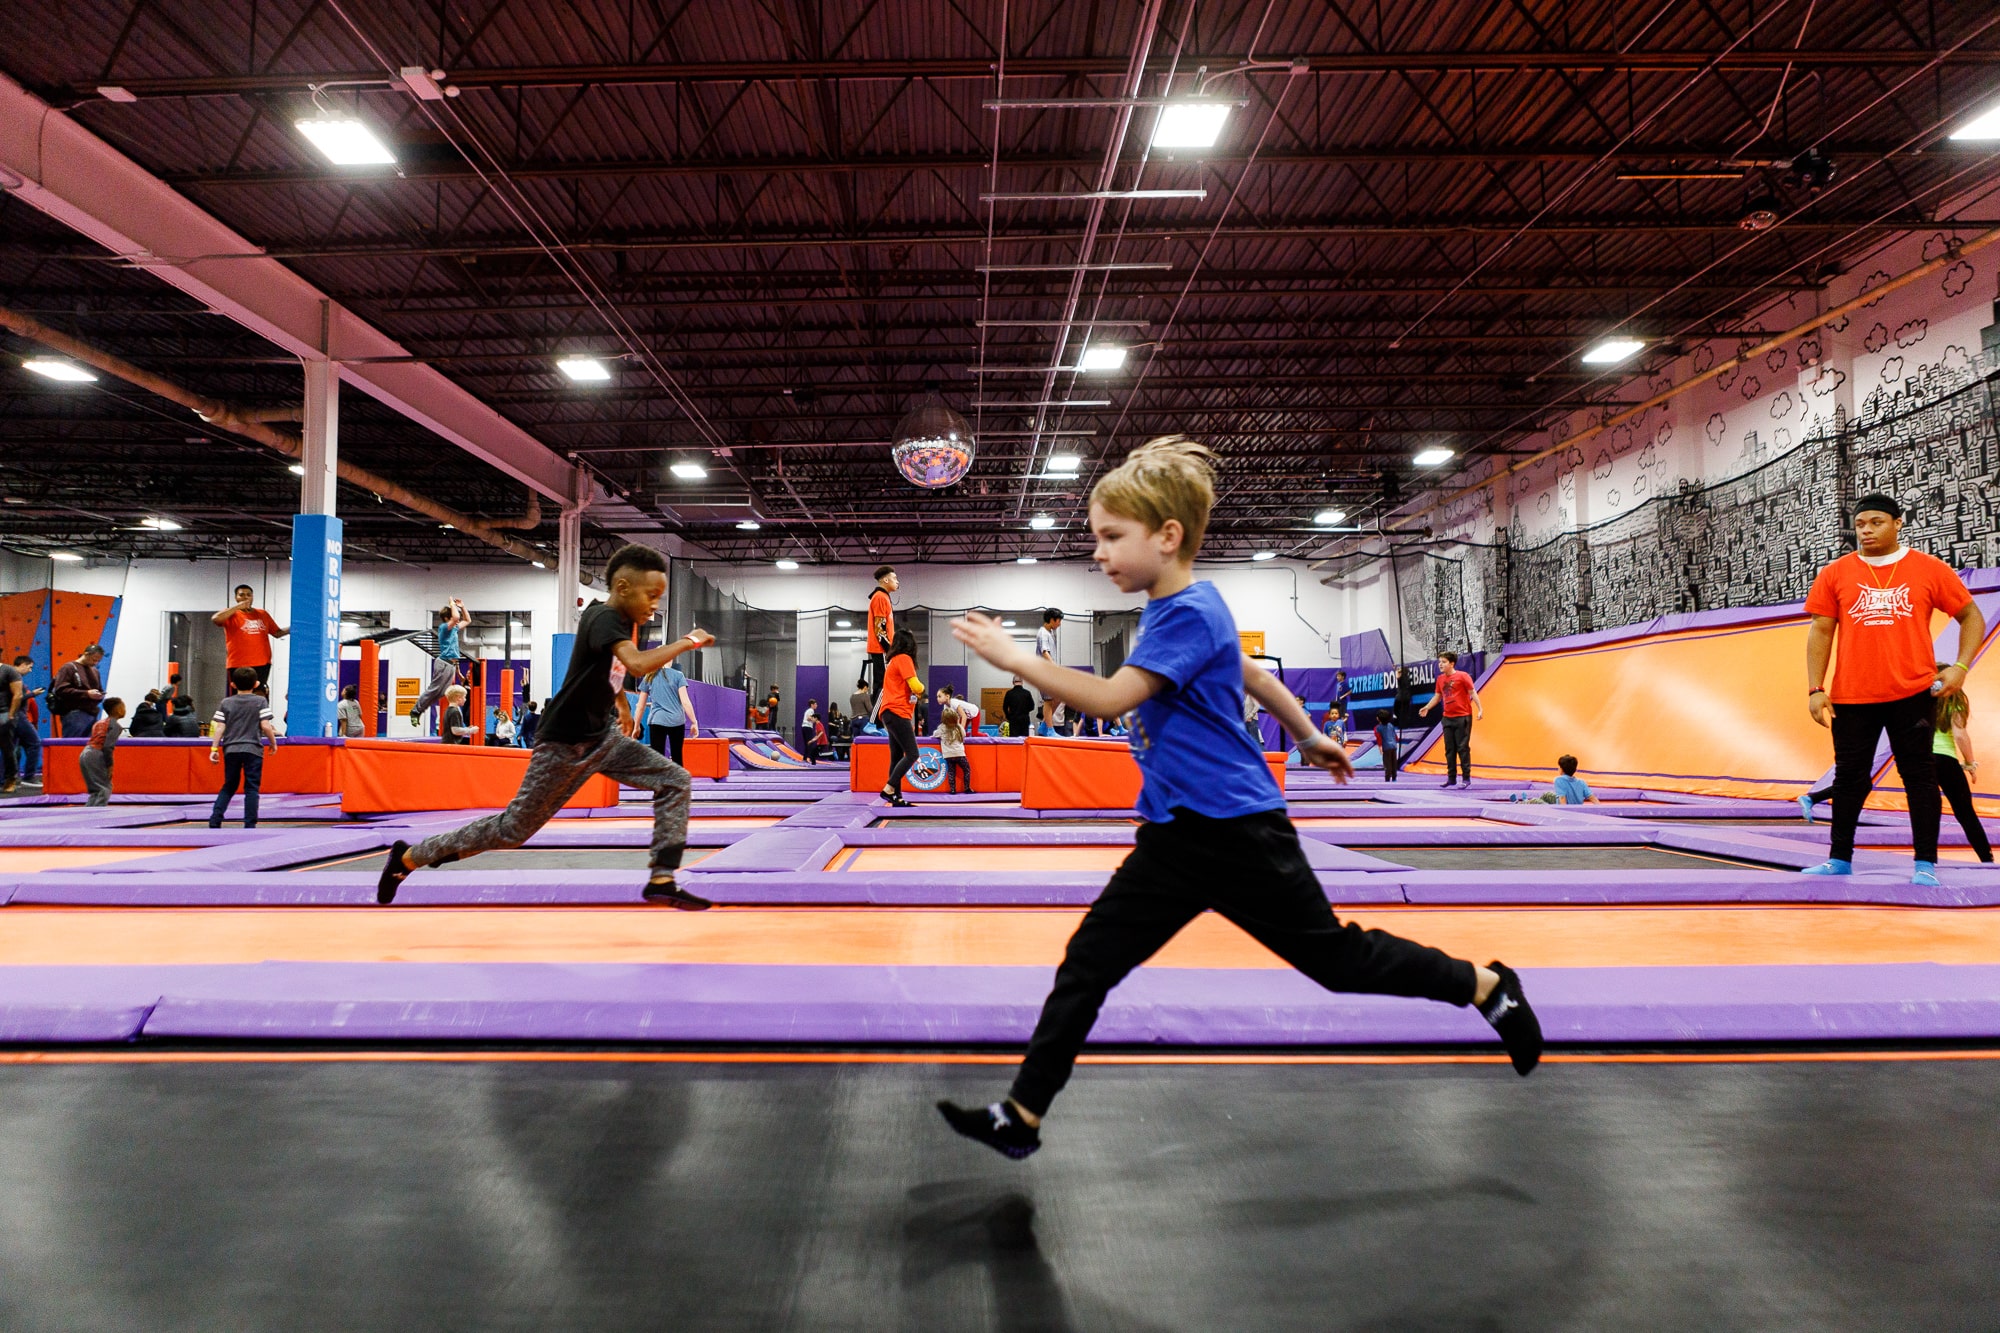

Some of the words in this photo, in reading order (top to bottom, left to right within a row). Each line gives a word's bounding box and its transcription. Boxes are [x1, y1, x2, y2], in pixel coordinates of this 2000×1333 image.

[326, 538, 342, 556] NO
[325, 556, 339, 703] RUNNING
[1348, 672, 1383, 694] EXTREME
[1383, 663, 1436, 690] DOBALL
